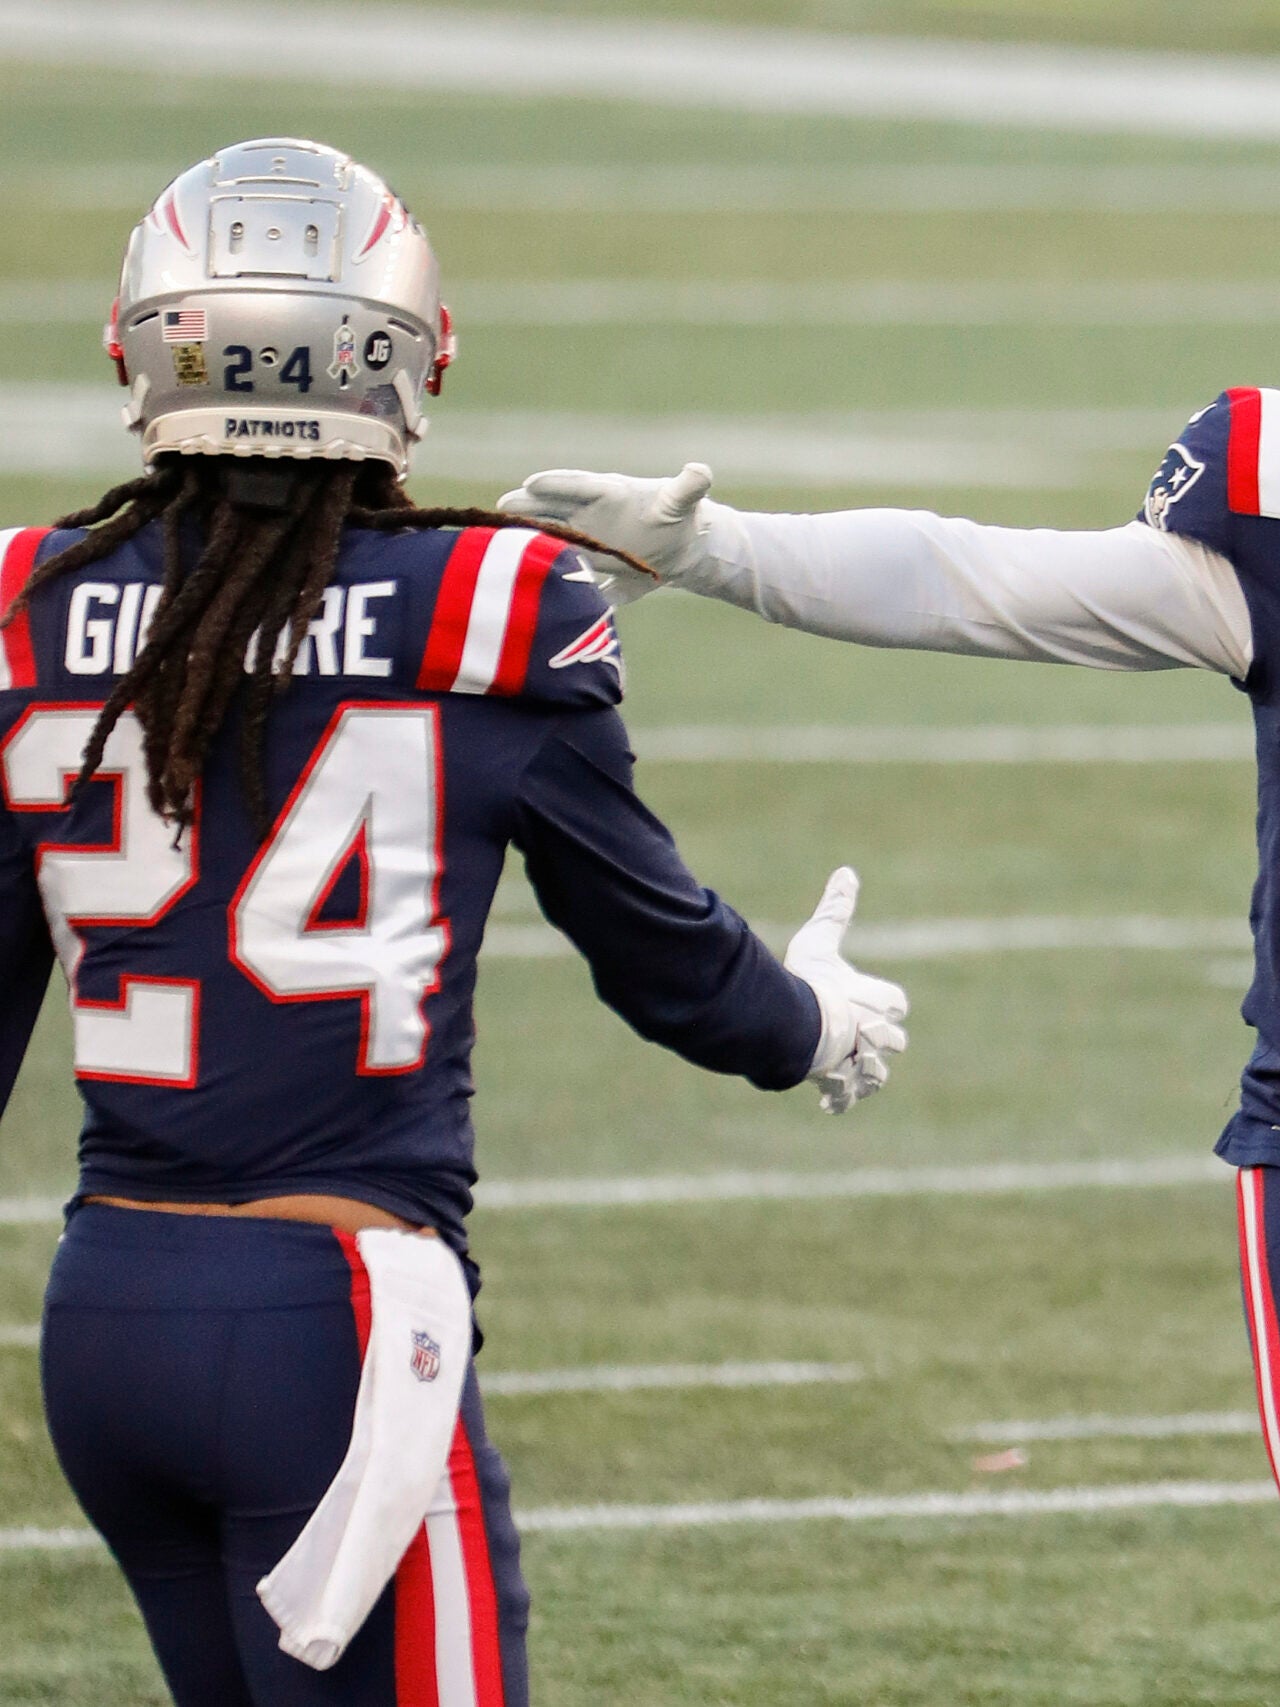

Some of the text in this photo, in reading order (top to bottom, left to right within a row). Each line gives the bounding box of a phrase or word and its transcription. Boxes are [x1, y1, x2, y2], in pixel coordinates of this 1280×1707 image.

[367, 338, 390, 362] JG
[222, 345, 314, 393] 24
[224, 418, 320, 441] PATRIOTS
[2, 701, 452, 1090] 24
[412, 1347, 436, 1379] NFL
